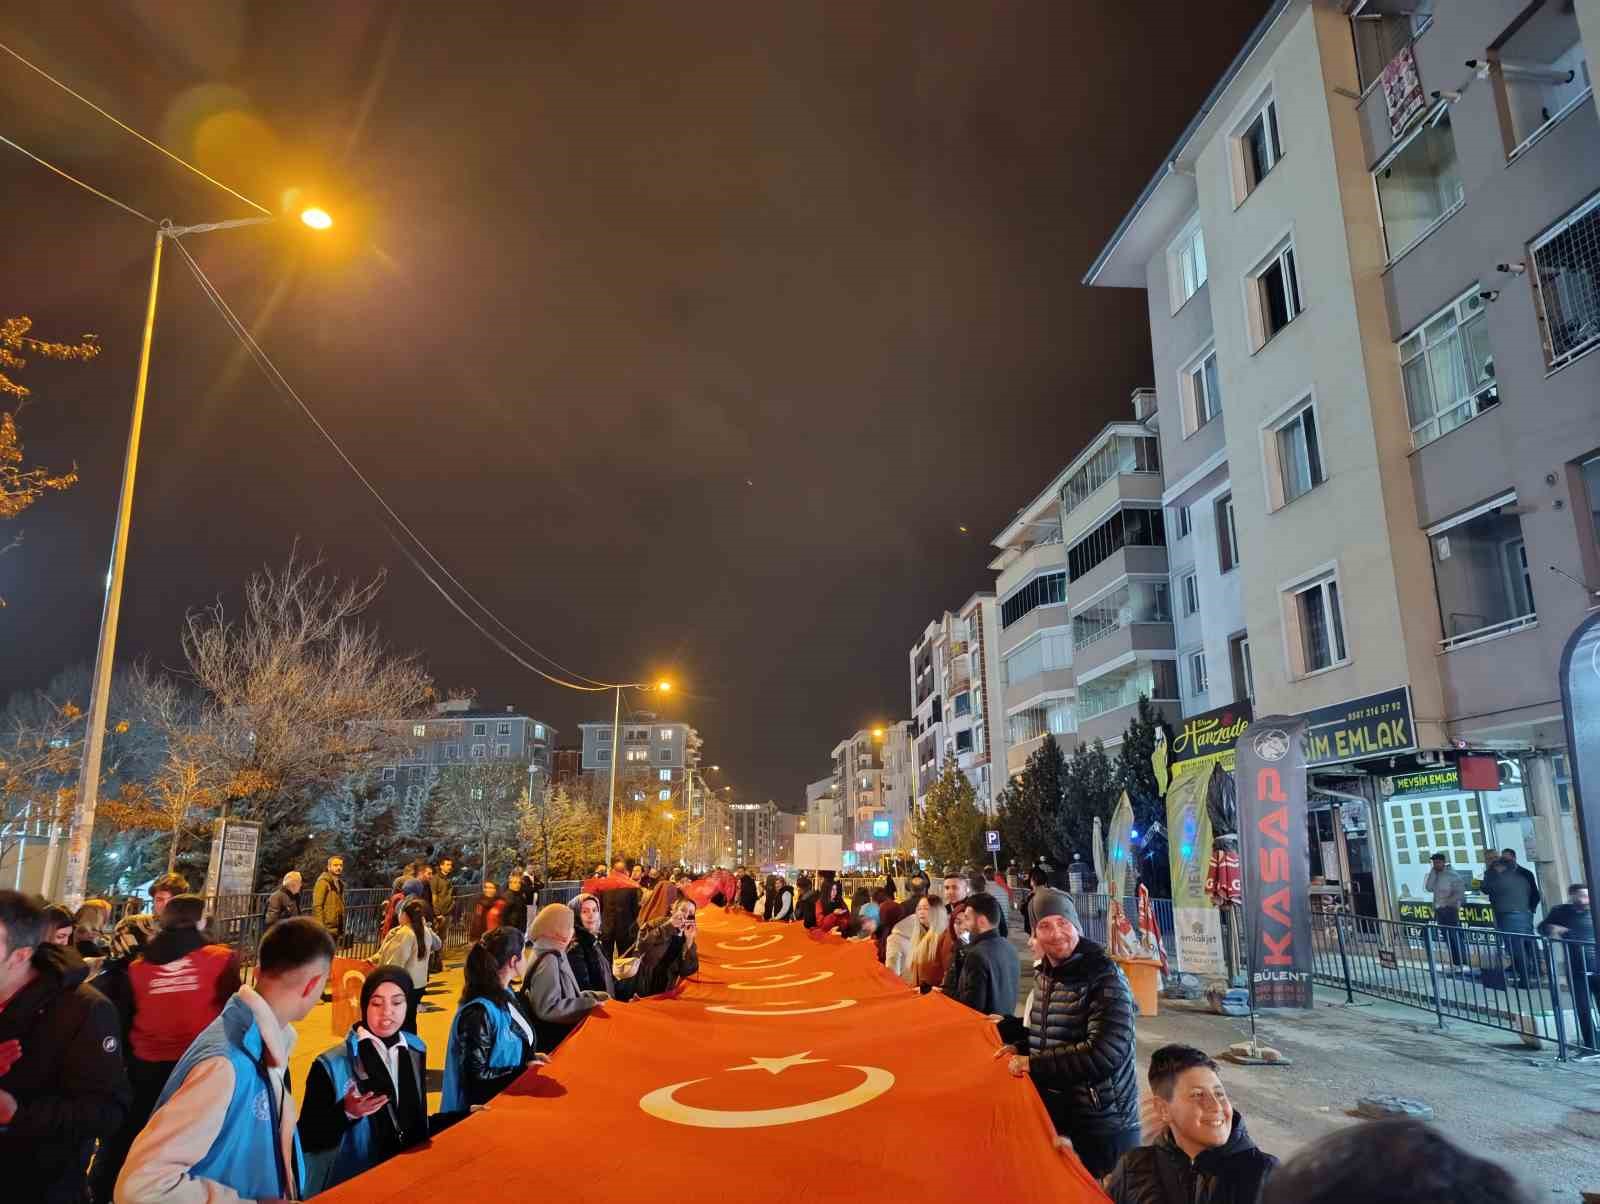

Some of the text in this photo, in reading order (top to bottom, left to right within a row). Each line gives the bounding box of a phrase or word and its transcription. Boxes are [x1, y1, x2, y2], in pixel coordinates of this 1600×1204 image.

[1334, 717, 1408, 757] EMLAK
[1429, 772, 1458, 785] EMLAK
[989, 832, 997, 844] P
[1257, 767, 1293, 966] KASAP
[1253, 968, 1309, 982] BÜLENT
